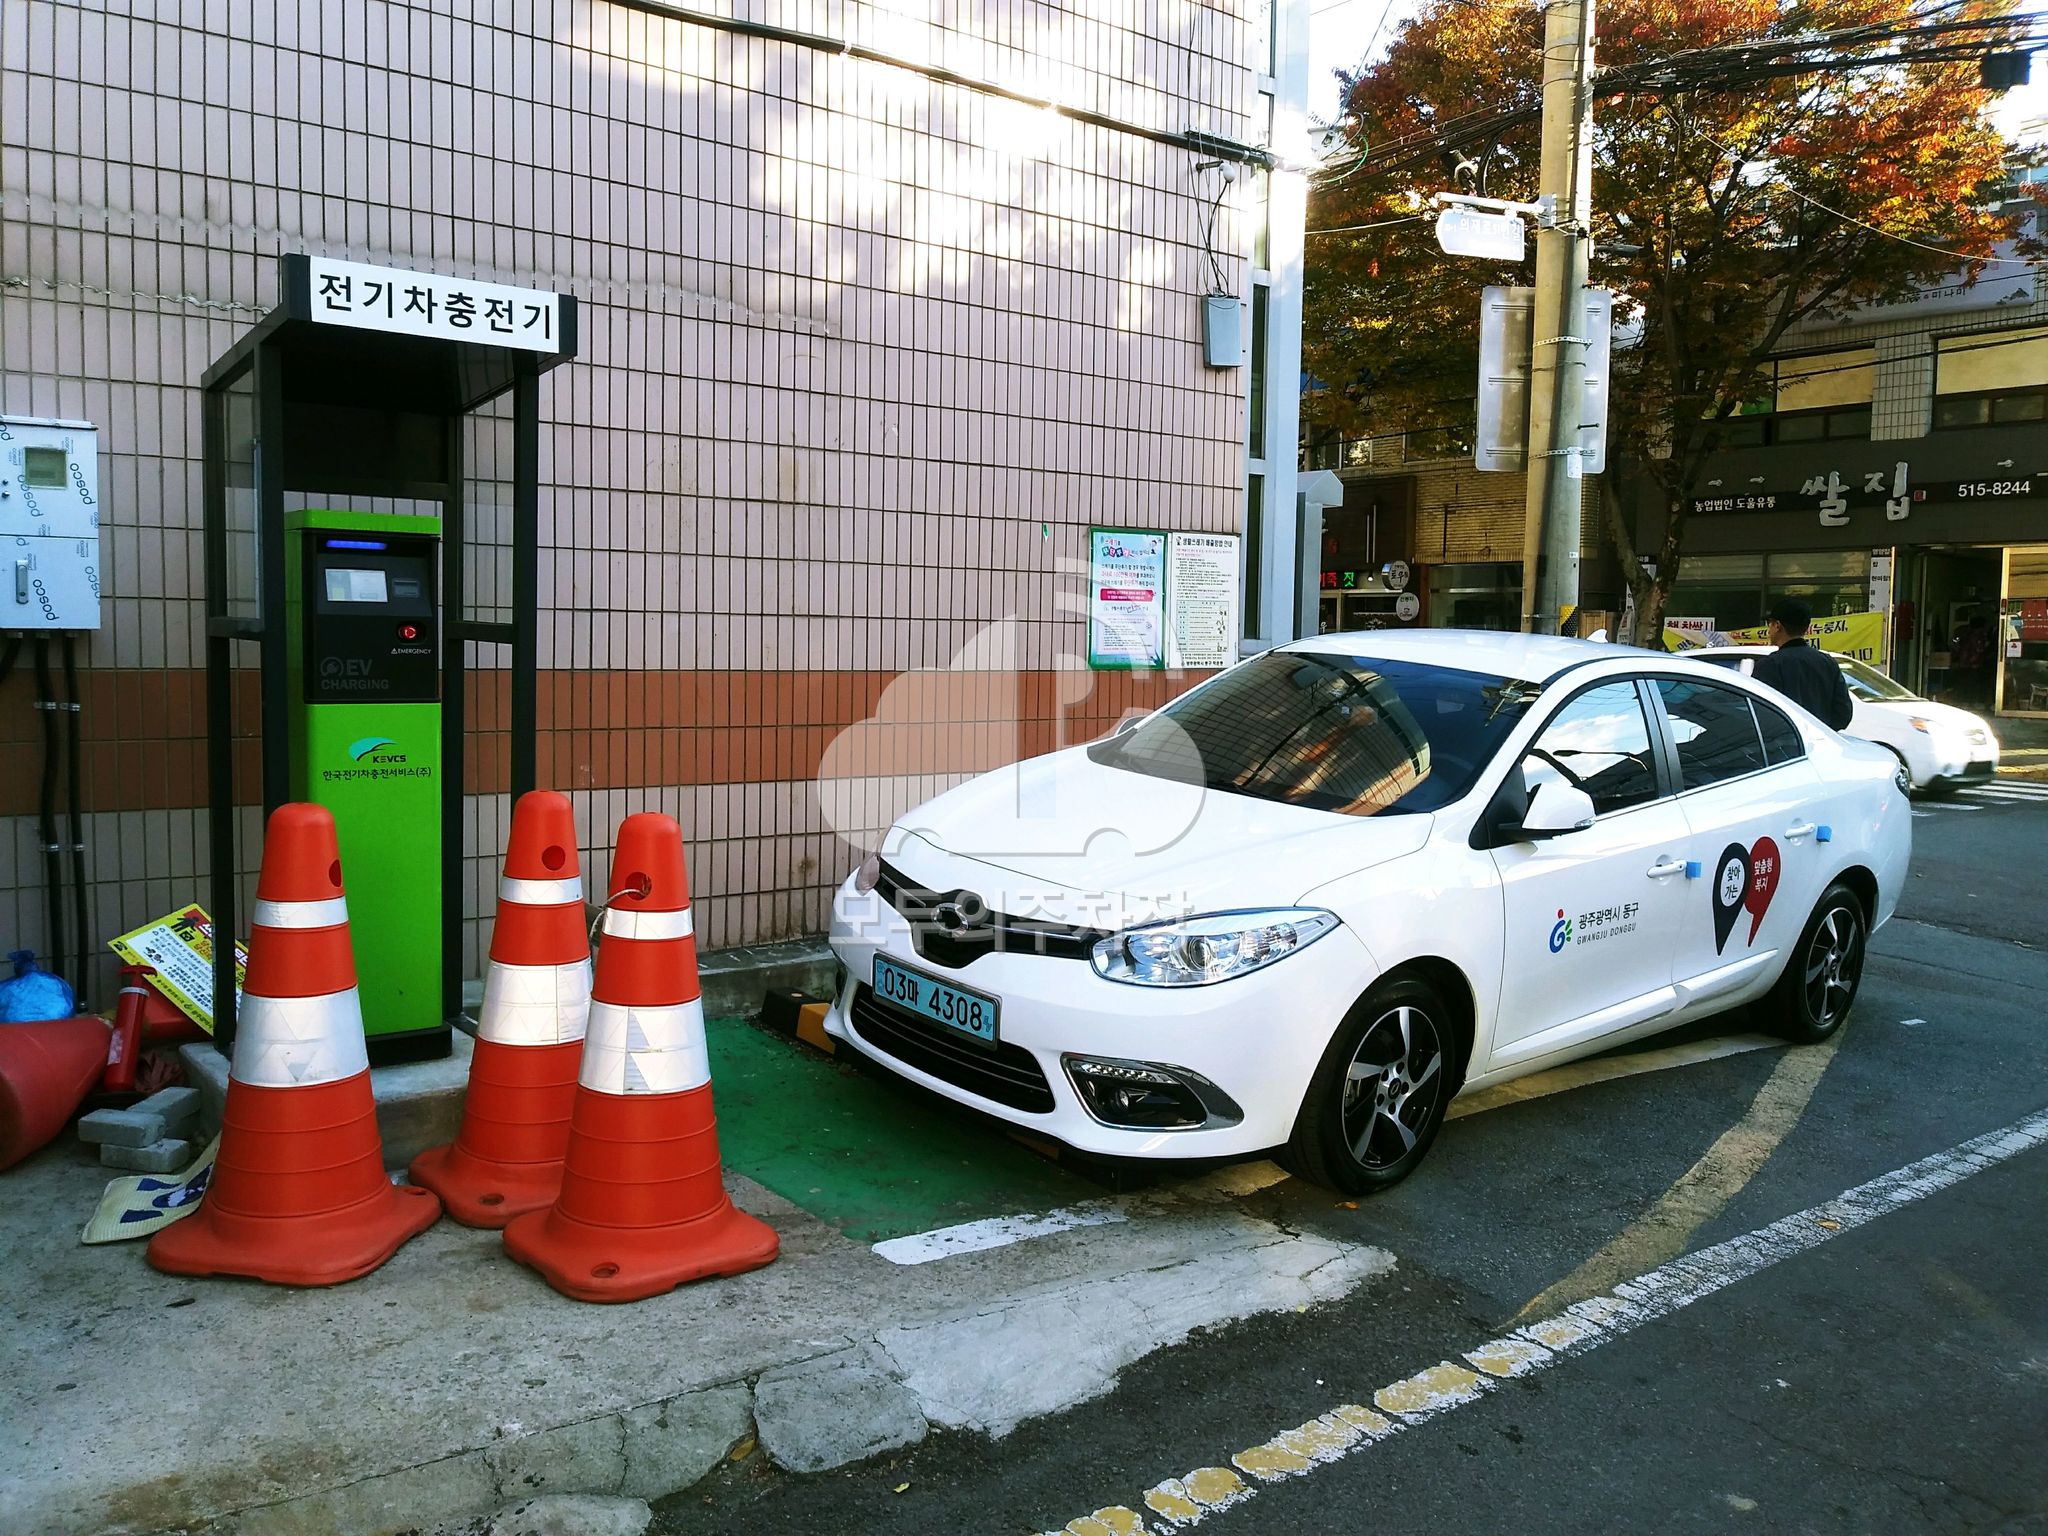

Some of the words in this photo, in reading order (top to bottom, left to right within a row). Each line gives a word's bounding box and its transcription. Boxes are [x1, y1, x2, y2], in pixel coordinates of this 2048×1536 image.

[319, 273, 550, 340] 전기차충전기
[69, 463, 97, 506] posco
[1958, 480, 2031, 498] 515-8244
[1800, 461, 1910, 527] 쌀집
[1695, 499, 1734, 513] 농업법인
[1183, 537, 1205, 546] 생활쓰레기
[1206, 539, 1223, 548] 배출방법
[1224, 540, 1233, 548] 안내
[32, 579, 60, 621] posco
[397, 647, 432, 655] EMERGENCY
[346, 659, 373, 676] EV
[321, 679, 390, 690] CHARGING
[372, 754, 406, 764] KEVCS
[322, 766, 432, 781] 한국전기차충전서비스(주)
[1726, 865, 1741, 882] 찾아
[1754, 857, 1774, 876] 맞춤형
[1724, 884, 1739, 900] 가는
[1754, 875, 1769, 893] 복지
[1578, 905, 1621, 930] 광주광역시
[1622, 902, 1640, 919] 동구
[1577, 932, 1609, 945] GWANGJU
[1609, 922, 1637, 937] DONGGU
[884, 967, 919, 1006] 03마
[928, 987, 982, 1031] 4308
